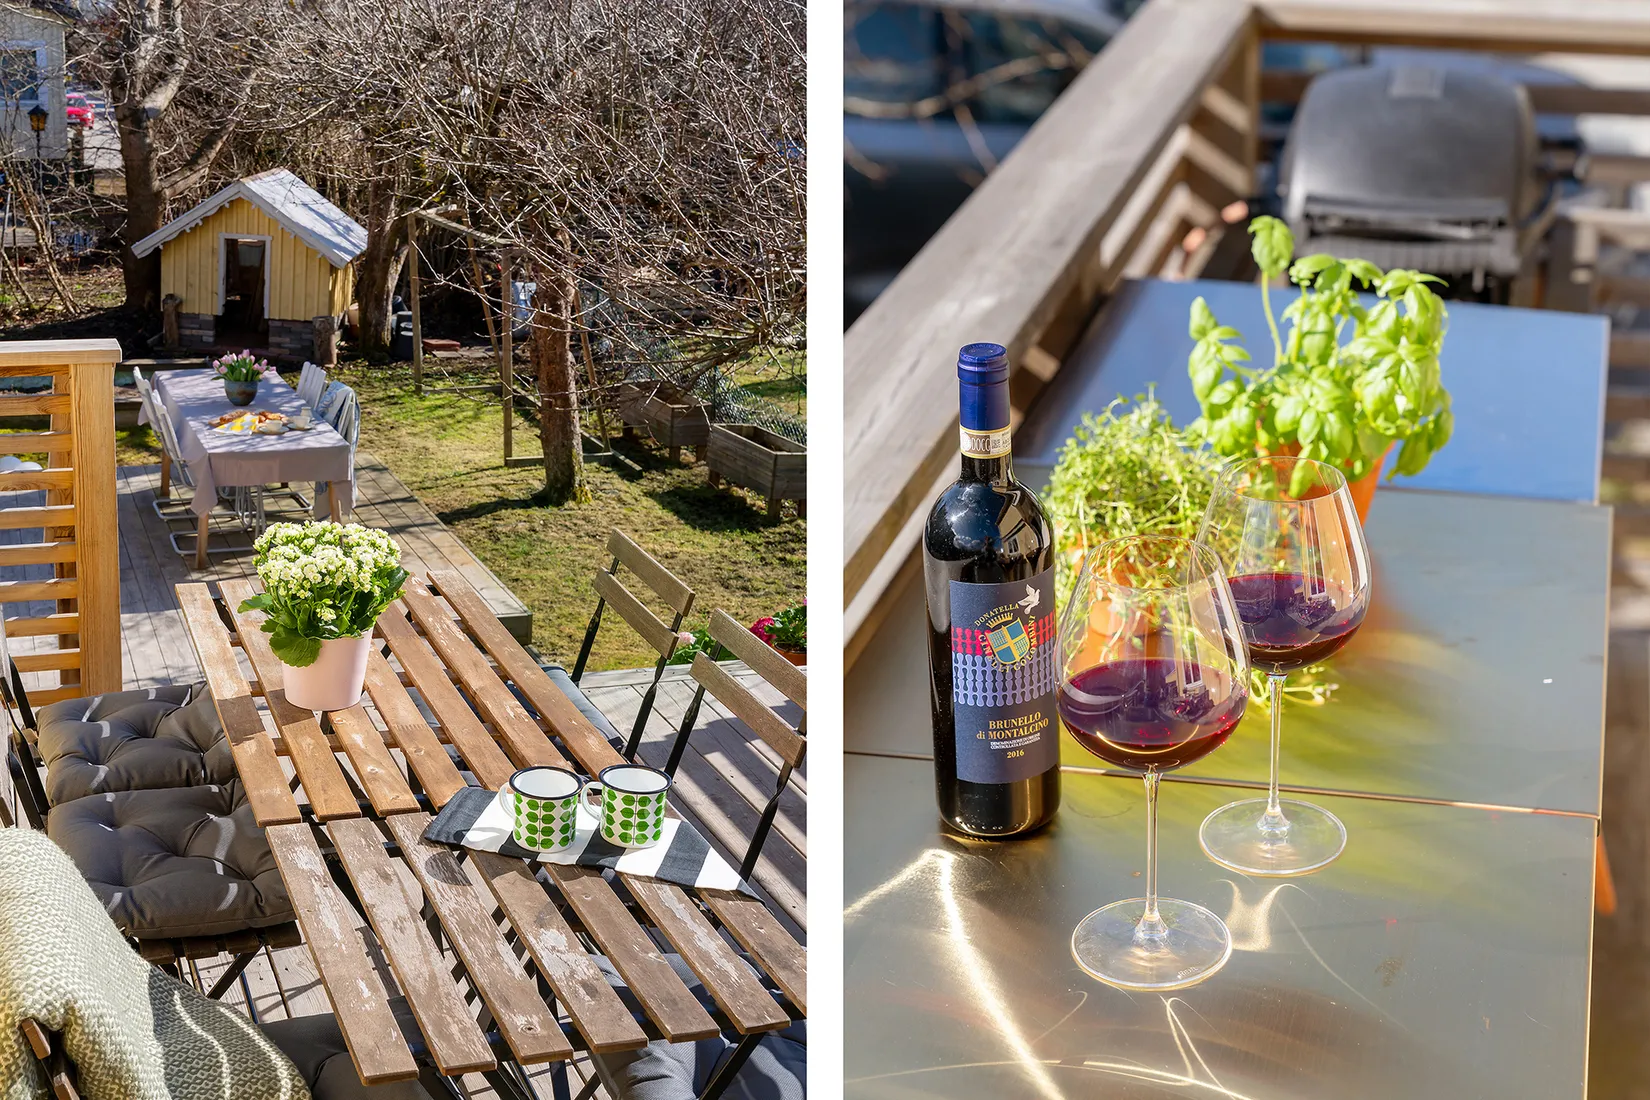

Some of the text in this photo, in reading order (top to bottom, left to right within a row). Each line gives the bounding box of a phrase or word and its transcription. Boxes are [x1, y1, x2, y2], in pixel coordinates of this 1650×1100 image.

[974, 603, 1019, 627] DONATELLA
[978, 615, 1037, 672] CINELLI COLOMBINI
[976, 717, 1049, 740] di MONTALCINO
[988, 712, 1041, 729] BRUNELLO
[1007, 749, 1025, 759] 2016
